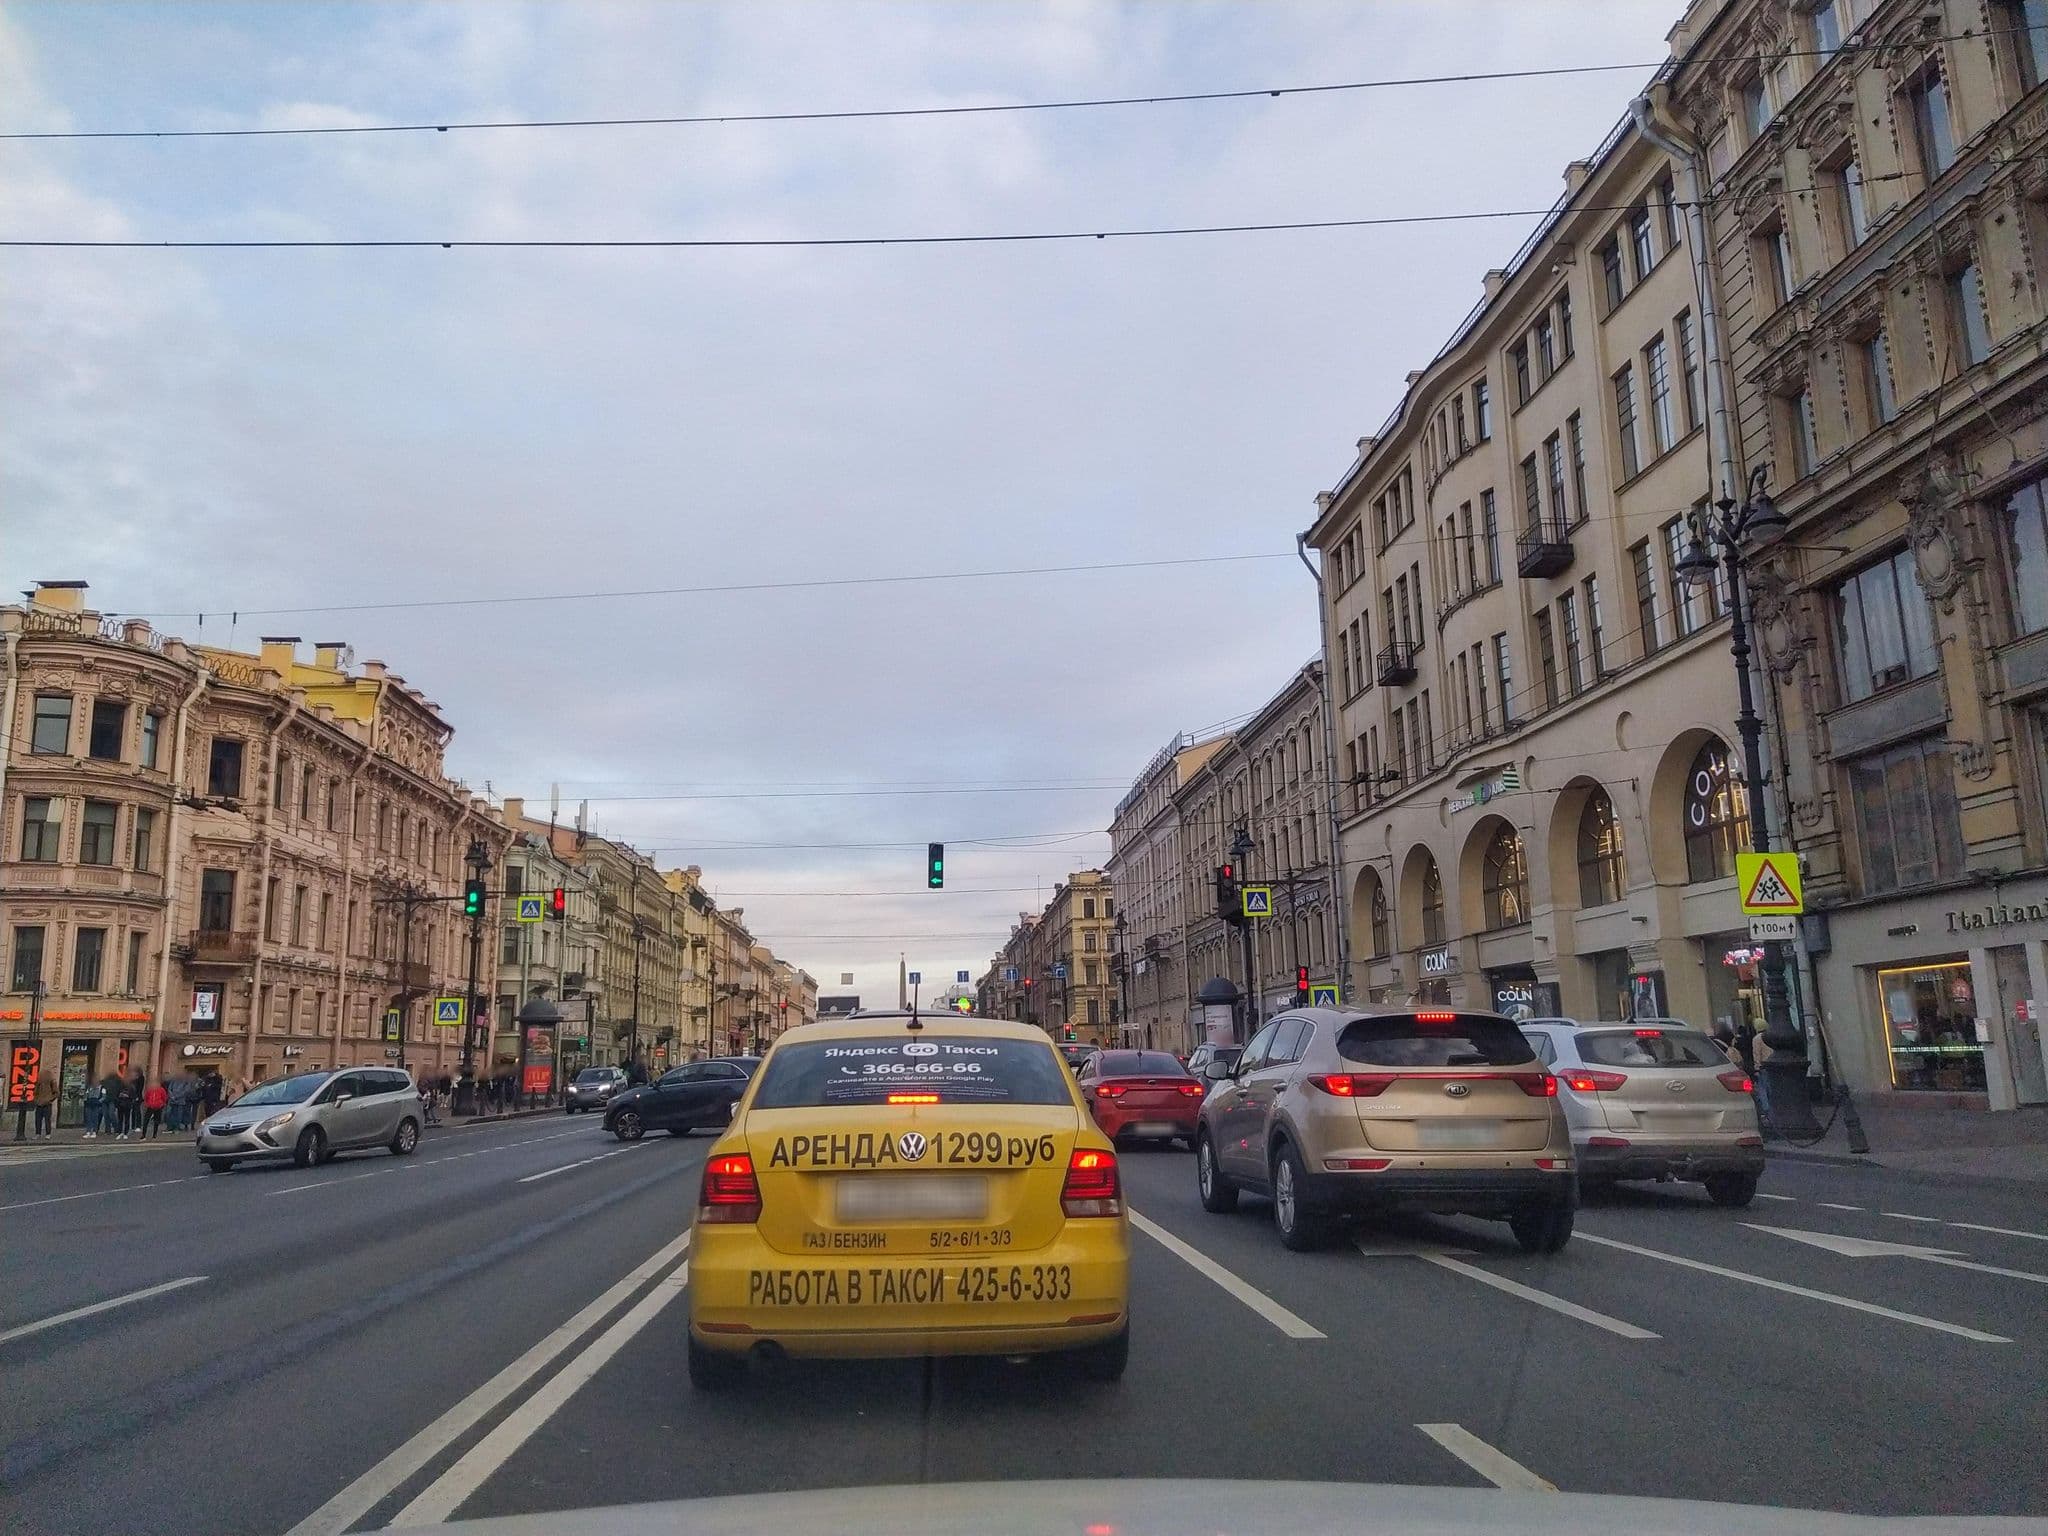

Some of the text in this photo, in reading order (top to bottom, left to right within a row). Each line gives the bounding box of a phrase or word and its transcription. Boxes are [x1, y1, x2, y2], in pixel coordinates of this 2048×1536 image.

[1945, 897, 2048, 933] Italian
[825, 1046, 899, 1058] Яндекс
[941, 1045, 999, 1056] Такси
[862, 1062, 982, 1075] 366-66-66
[769, 1133, 899, 1168] АРЕНДА
[930, 1131, 1004, 1164] 1299
[1007, 1134, 1056, 1166] руб
[750, 1264, 1072, 1305] РАБОТА В ТАКСИ 425-6-333
